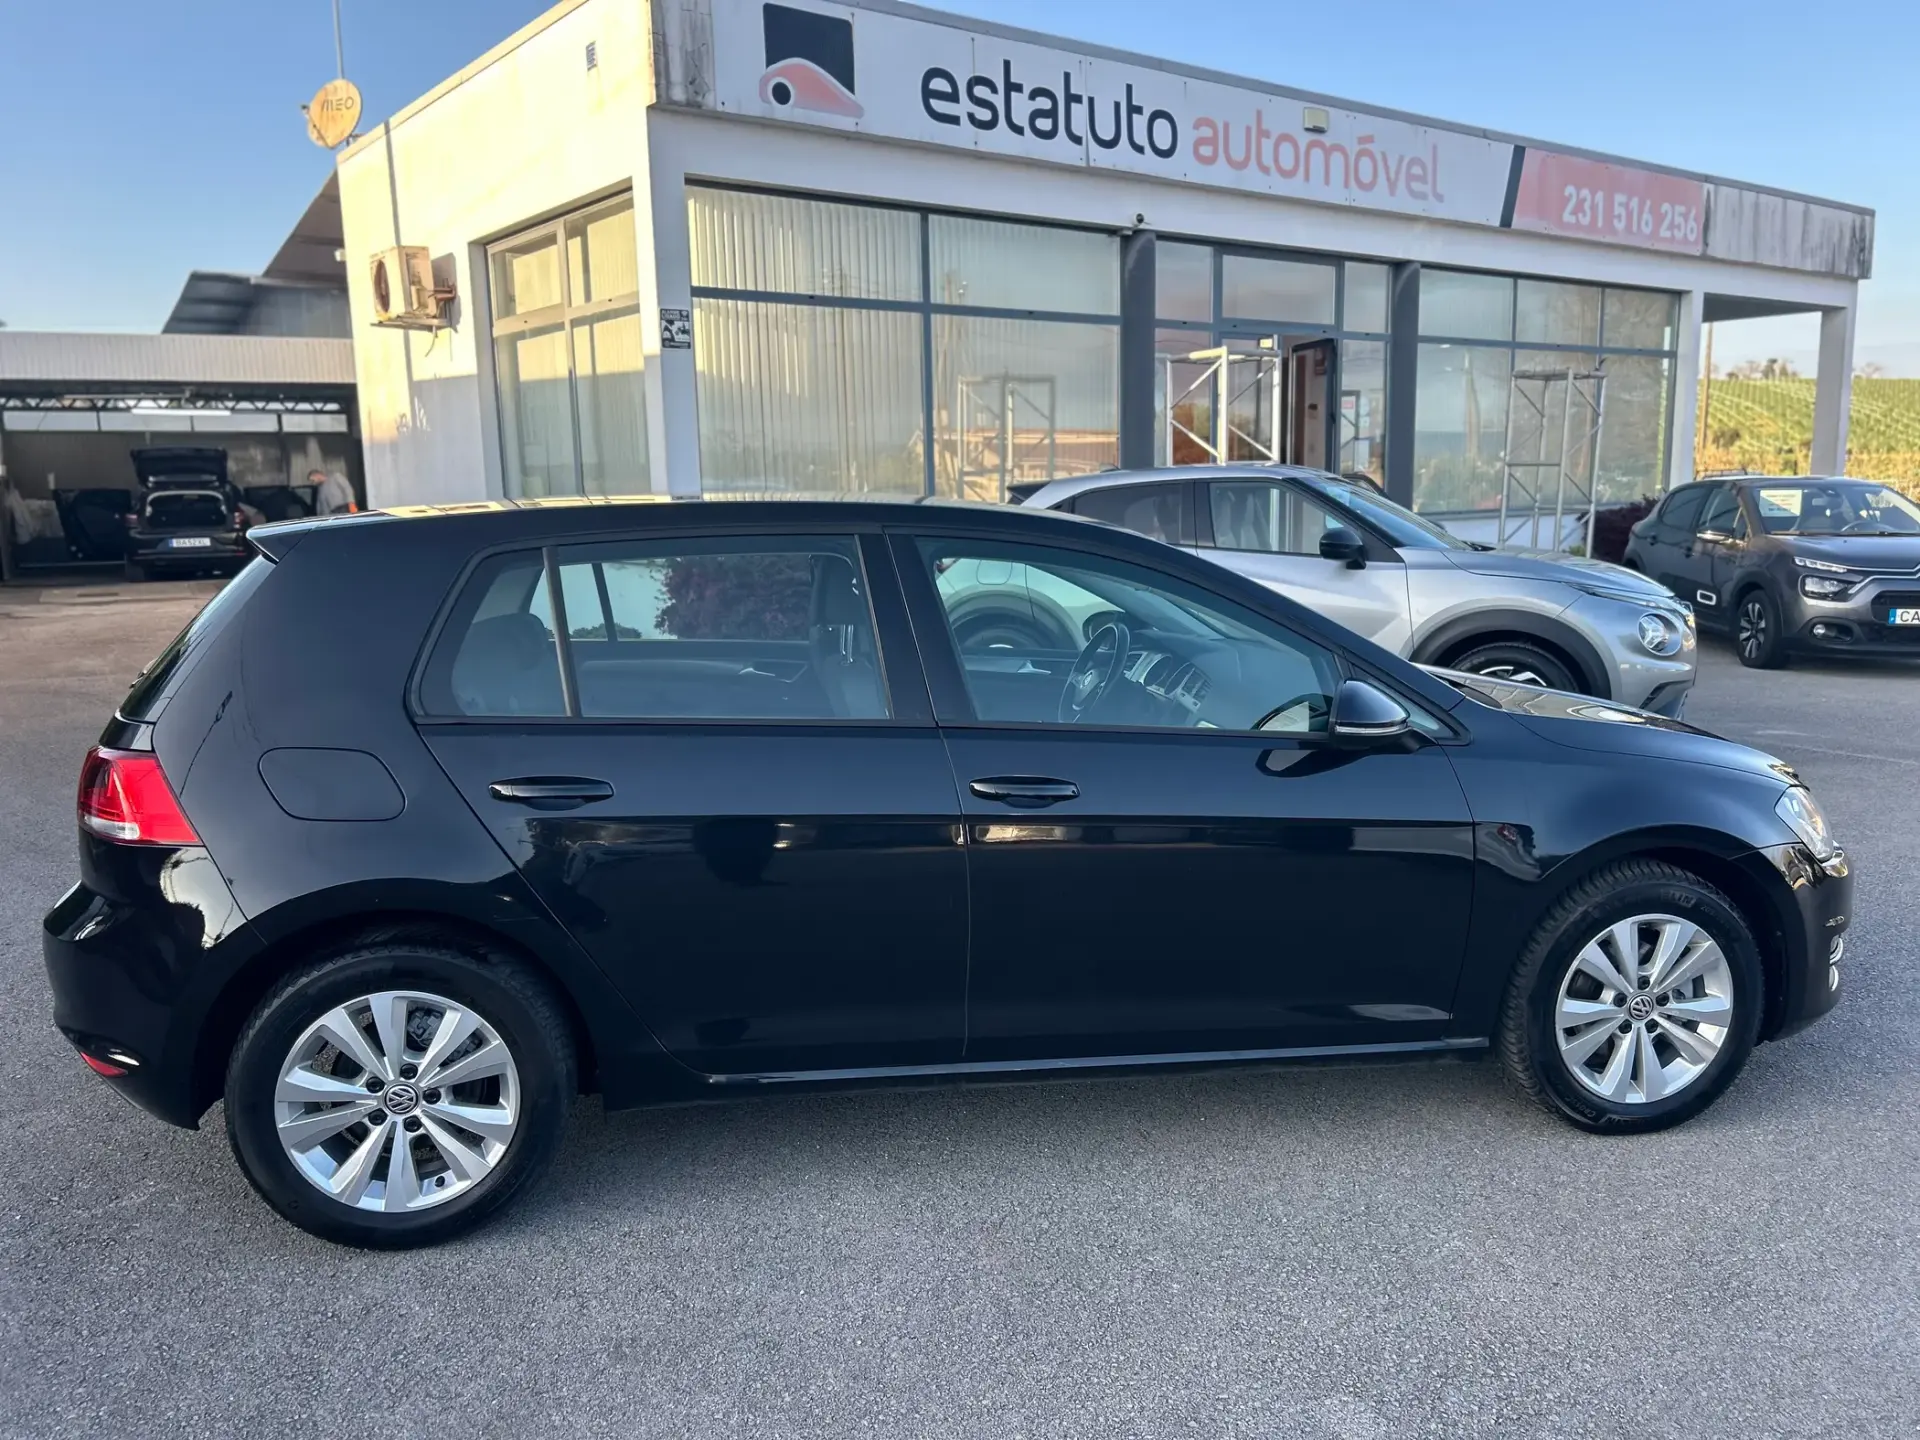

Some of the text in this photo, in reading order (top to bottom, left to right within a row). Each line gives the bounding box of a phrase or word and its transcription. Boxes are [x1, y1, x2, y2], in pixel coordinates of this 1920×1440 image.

[322, 96, 354, 111] MEO
[921, 58, 1444, 203] estatuto automóvel
[1562, 184, 1697, 242] 231 516 256
